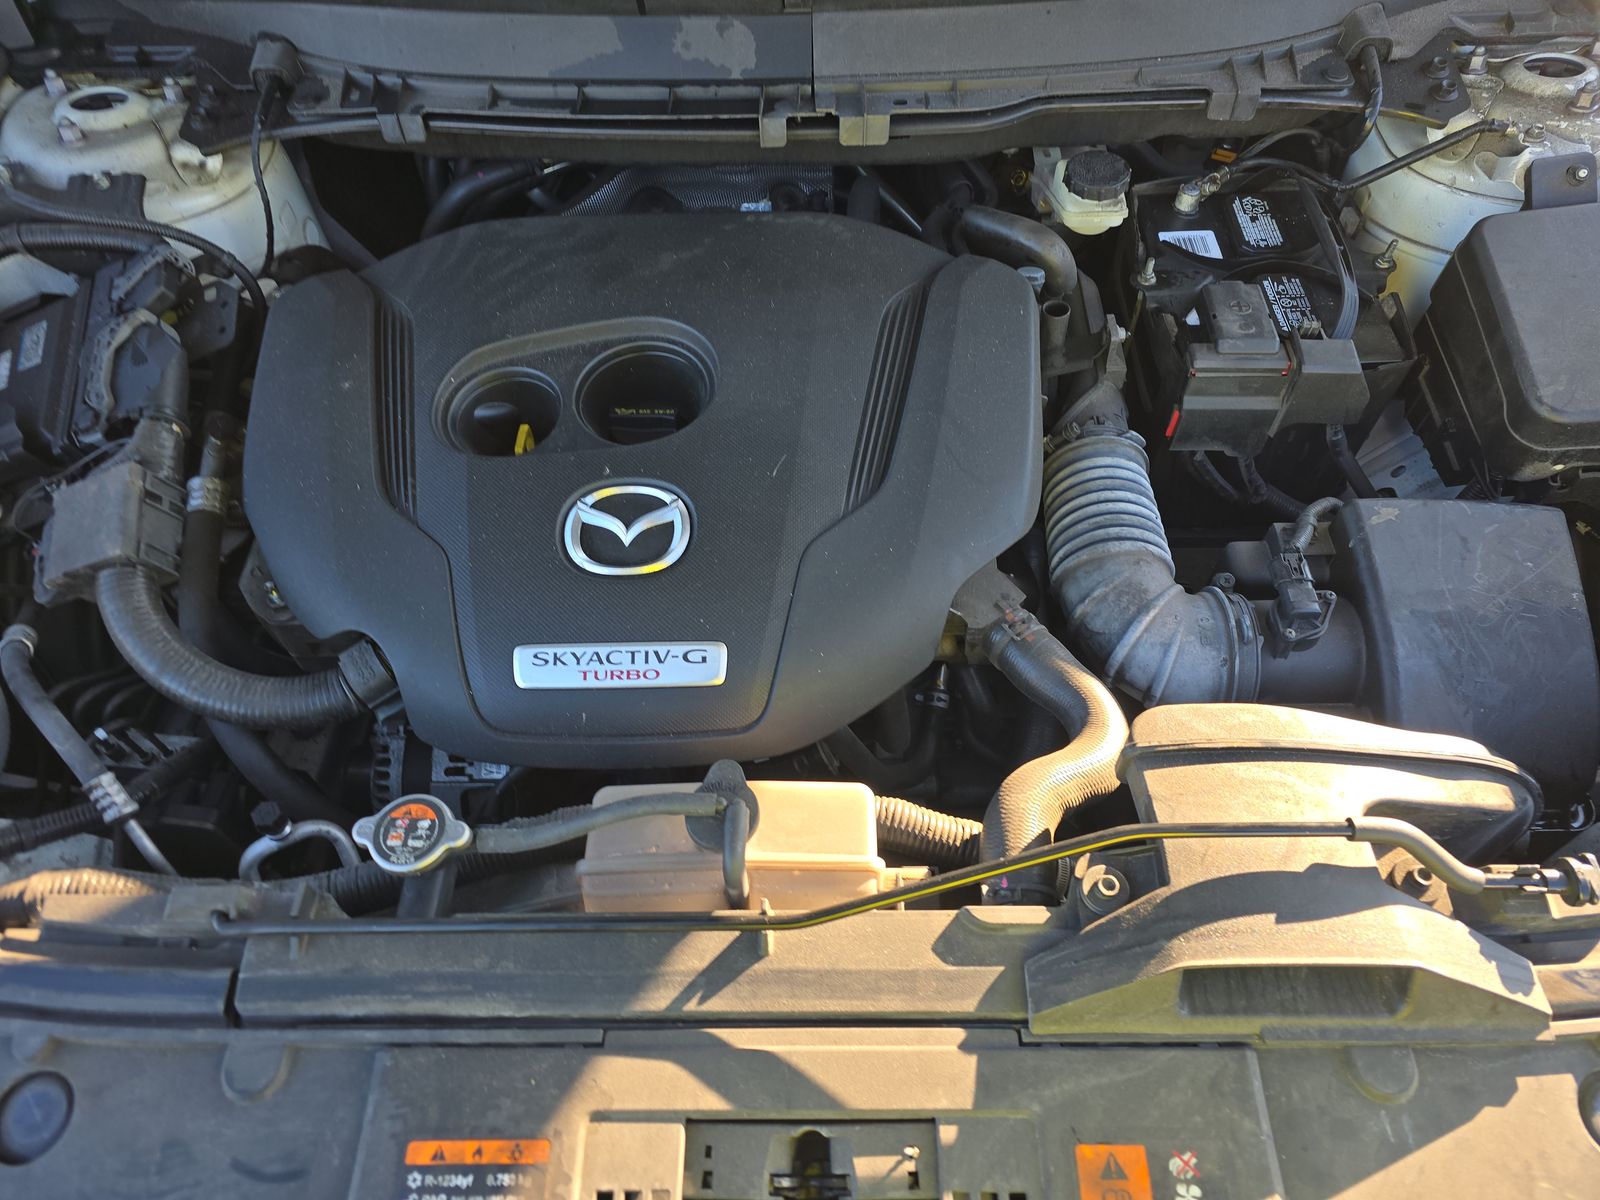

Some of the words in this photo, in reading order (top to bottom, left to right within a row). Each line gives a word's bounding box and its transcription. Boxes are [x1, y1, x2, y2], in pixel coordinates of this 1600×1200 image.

[531, 648, 708, 667] SKYACTIV-G
[577, 668, 661, 682] TURBO
[424, 1173, 474, 1190] R-1234yf
